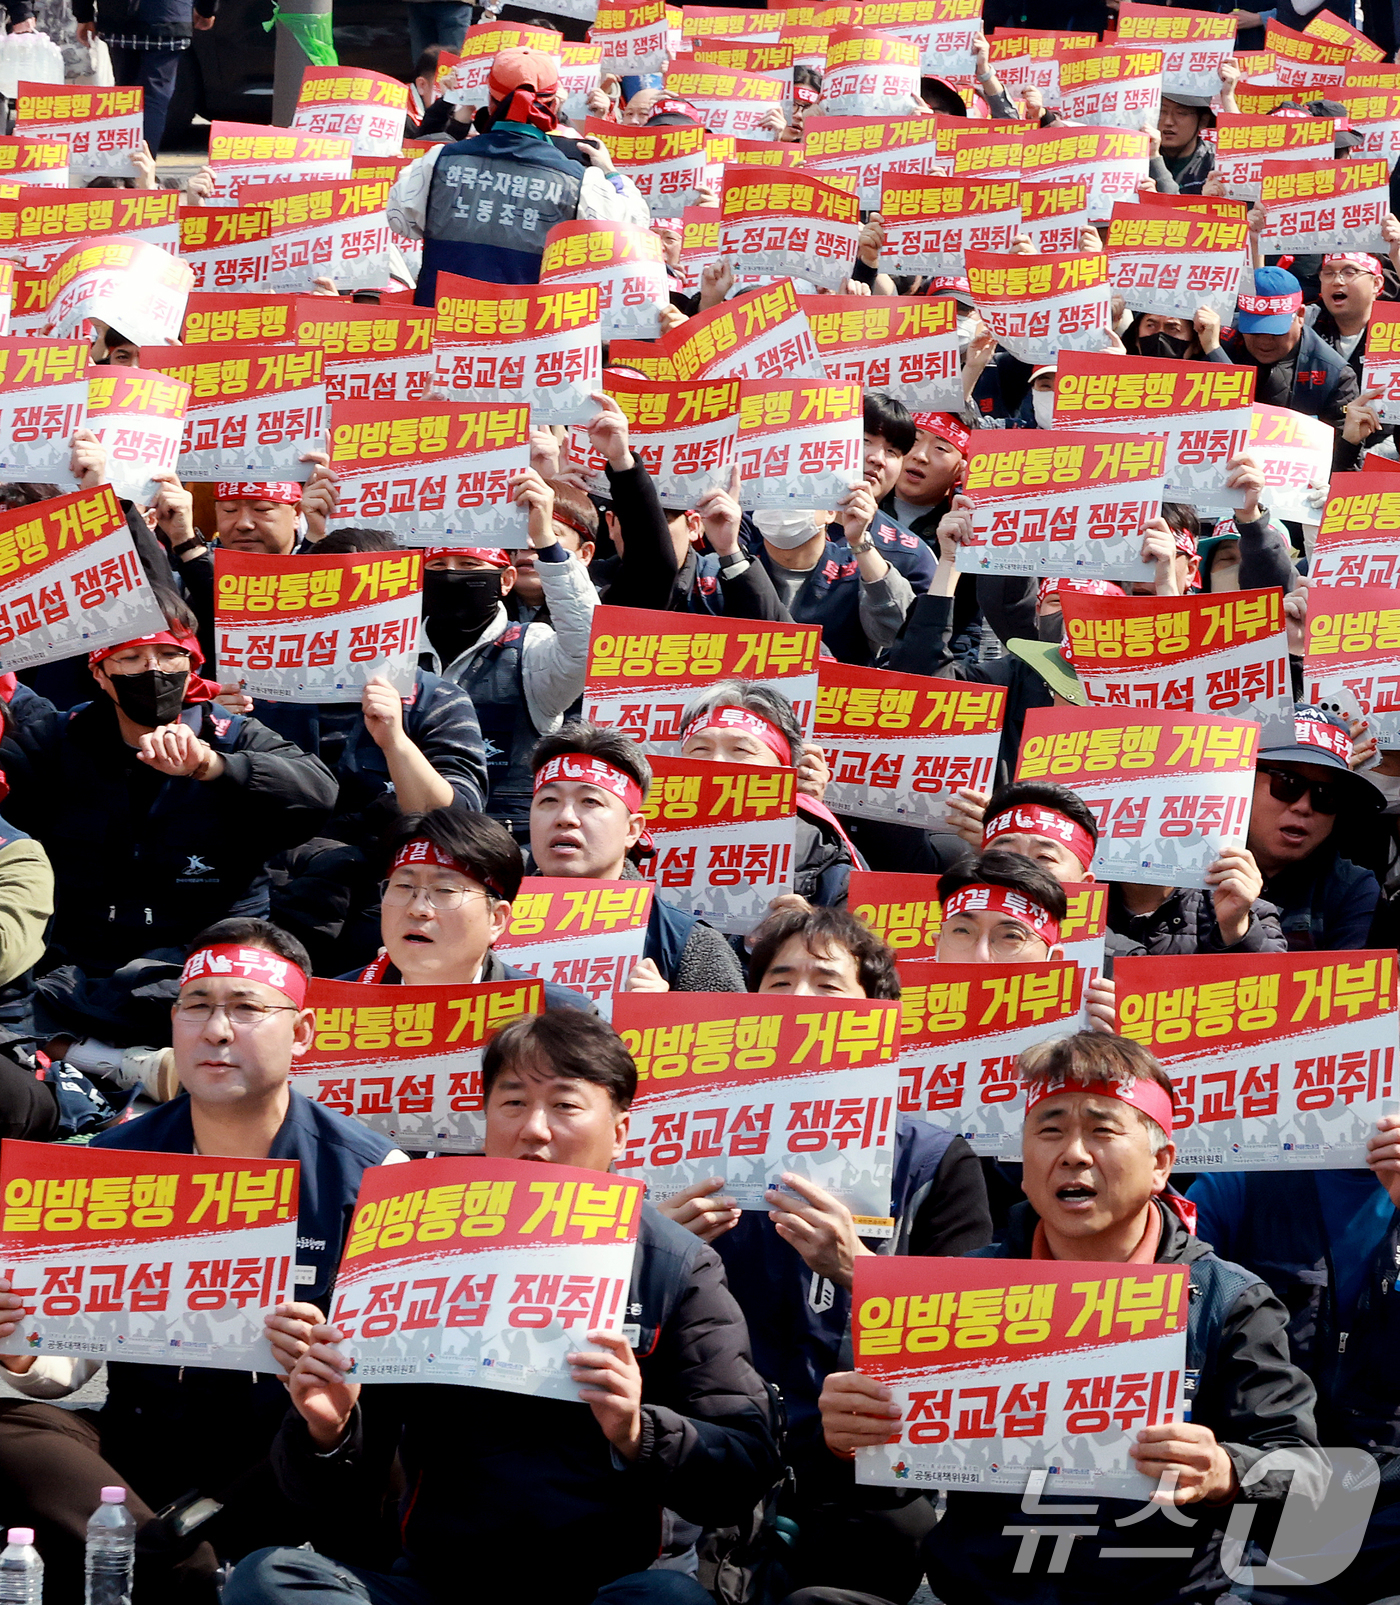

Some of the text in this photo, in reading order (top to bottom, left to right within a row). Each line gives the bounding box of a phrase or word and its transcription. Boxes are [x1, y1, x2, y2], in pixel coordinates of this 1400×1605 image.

[630, 2, 667, 25] 거부!
[681, 13, 787, 35] 일방통행 거부!
[861, 0, 981, 24] 일방통행 거부!
[1118, 17, 1236, 38] 일방통행 거부!
[558, 47, 602, 64] 거부!
[752, 42, 795, 68] 거부!
[992, 37, 1028, 58] 거부!
[1264, 28, 1354, 63] 일방통행 거부!
[666, 74, 782, 100] 일방통행 거부!
[1061, 53, 1162, 85] 일방통행 거부!
[18, 90, 141, 119] 일방통행 거부!
[300, 78, 408, 108] 일방통행 거부!
[1125, 89, 1159, 110] 쟁취!
[98, 128, 140, 151] 쟁취!
[211, 137, 350, 159] 일방통행 거부!
[661, 128, 704, 156] 거부!
[803, 119, 938, 156] 일방통행 거부!
[1020, 134, 1148, 167] 일방통행 거부!
[1218, 121, 1333, 149] 일방통행 거부!
[23, 145, 68, 167] 거부!
[339, 182, 389, 214] 거부!
[446, 164, 561, 205] 한국수자원공사
[882, 182, 1022, 215] 일방통행 거부!
[1039, 186, 1085, 212] 거부!
[1262, 162, 1386, 200] 일방통행 거부!
[21, 194, 177, 236] 일방통행 거부!
[724, 184, 858, 222] 일방통행 거부!
[1261, 202, 1388, 237] 노정교섭 쟁취!
[214, 211, 272, 241] 거부!
[342, 227, 389, 259] 쟁취!
[721, 225, 858, 261] 노정교섭 쟁취!
[881, 225, 1020, 256] 노정교섭 쟁취!
[1108, 218, 1247, 249] 일방통행 거부!
[215, 256, 269, 286] 쟁취!
[969, 256, 1107, 295] 일방통행 거부!
[1187, 266, 1238, 291] 쟁취!
[186, 306, 288, 343] 일방통행
[437, 288, 597, 334] 일방통행 거부!
[897, 301, 954, 335] 거부!
[1059, 302, 1108, 334] 쟁취!
[298, 320, 399, 354] 일방통행
[672, 282, 797, 380] 일방통행 거부!
[14, 345, 86, 382] 거부!
[257, 350, 327, 389] 거부!
[433, 346, 598, 389] 노정교섭 쟁취!
[755, 330, 814, 381] 쟁취!
[899, 350, 956, 383] 쟁취!
[115, 375, 192, 416] 거부!
[668, 379, 742, 422] 거부!
[799, 386, 860, 420] 거부!
[1057, 372, 1253, 410] 일방통행 거부!
[12, 404, 82, 442] 쟁취!
[257, 407, 322, 444] 쟁취!
[333, 408, 528, 461] 일방통행 거부!
[114, 430, 177, 465] 쟁취!
[673, 435, 736, 476] 쟁취!
[800, 440, 859, 474] 쟁취!
[966, 442, 1164, 489] 일방통행 거부!
[50, 489, 120, 549] 거부!
[877, 524, 919, 549] 투쟁
[70, 550, 142, 609] 쟁취!
[219, 555, 420, 611] 일방통행 거부!
[219, 617, 418, 670] 노정교섭 쟁취!
[1069, 593, 1278, 657] 일방통행 거부!
[591, 632, 817, 676] 일방통행 거부!
[1207, 658, 1285, 710] 쟁취!
[719, 709, 767, 735] 투쟁
[815, 686, 1003, 730] 방통행 거부!
[1019, 726, 1256, 779] 일방통행 거부!
[587, 759, 629, 796] 투쟁
[912, 756, 993, 794] 쟁취!
[710, 774, 793, 816] 거부!
[986, 810, 1074, 842] 단결 투쟁
[1160, 796, 1247, 837] 쟁취!
[709, 844, 791, 886] 쟁취!
[552, 888, 650, 930] 거부!
[947, 888, 1049, 929] 단결 투쟁
[234, 950, 288, 988] 투쟁
[980, 967, 1074, 1024] 거부!
[1120, 958, 1392, 1045] 일방통행 거부!
[790, 1009, 898, 1064] 거부!
[1294, 1047, 1394, 1111] 쟁취!
[787, 1097, 892, 1152] 쟁취!
[3, 1168, 294, 1231] 일방통행 거부!
[346, 1181, 639, 1258] 일방통행 거부!
[186, 1256, 292, 1312] 쟁취!
[333, 1273, 624, 1340] 노정교섭 쟁취!
[859, 1274, 1184, 1355] 일방통행 거부!
[1064, 1370, 1181, 1437] 쟁취!
[914, 1470, 980, 1484] 공동대책위원회
